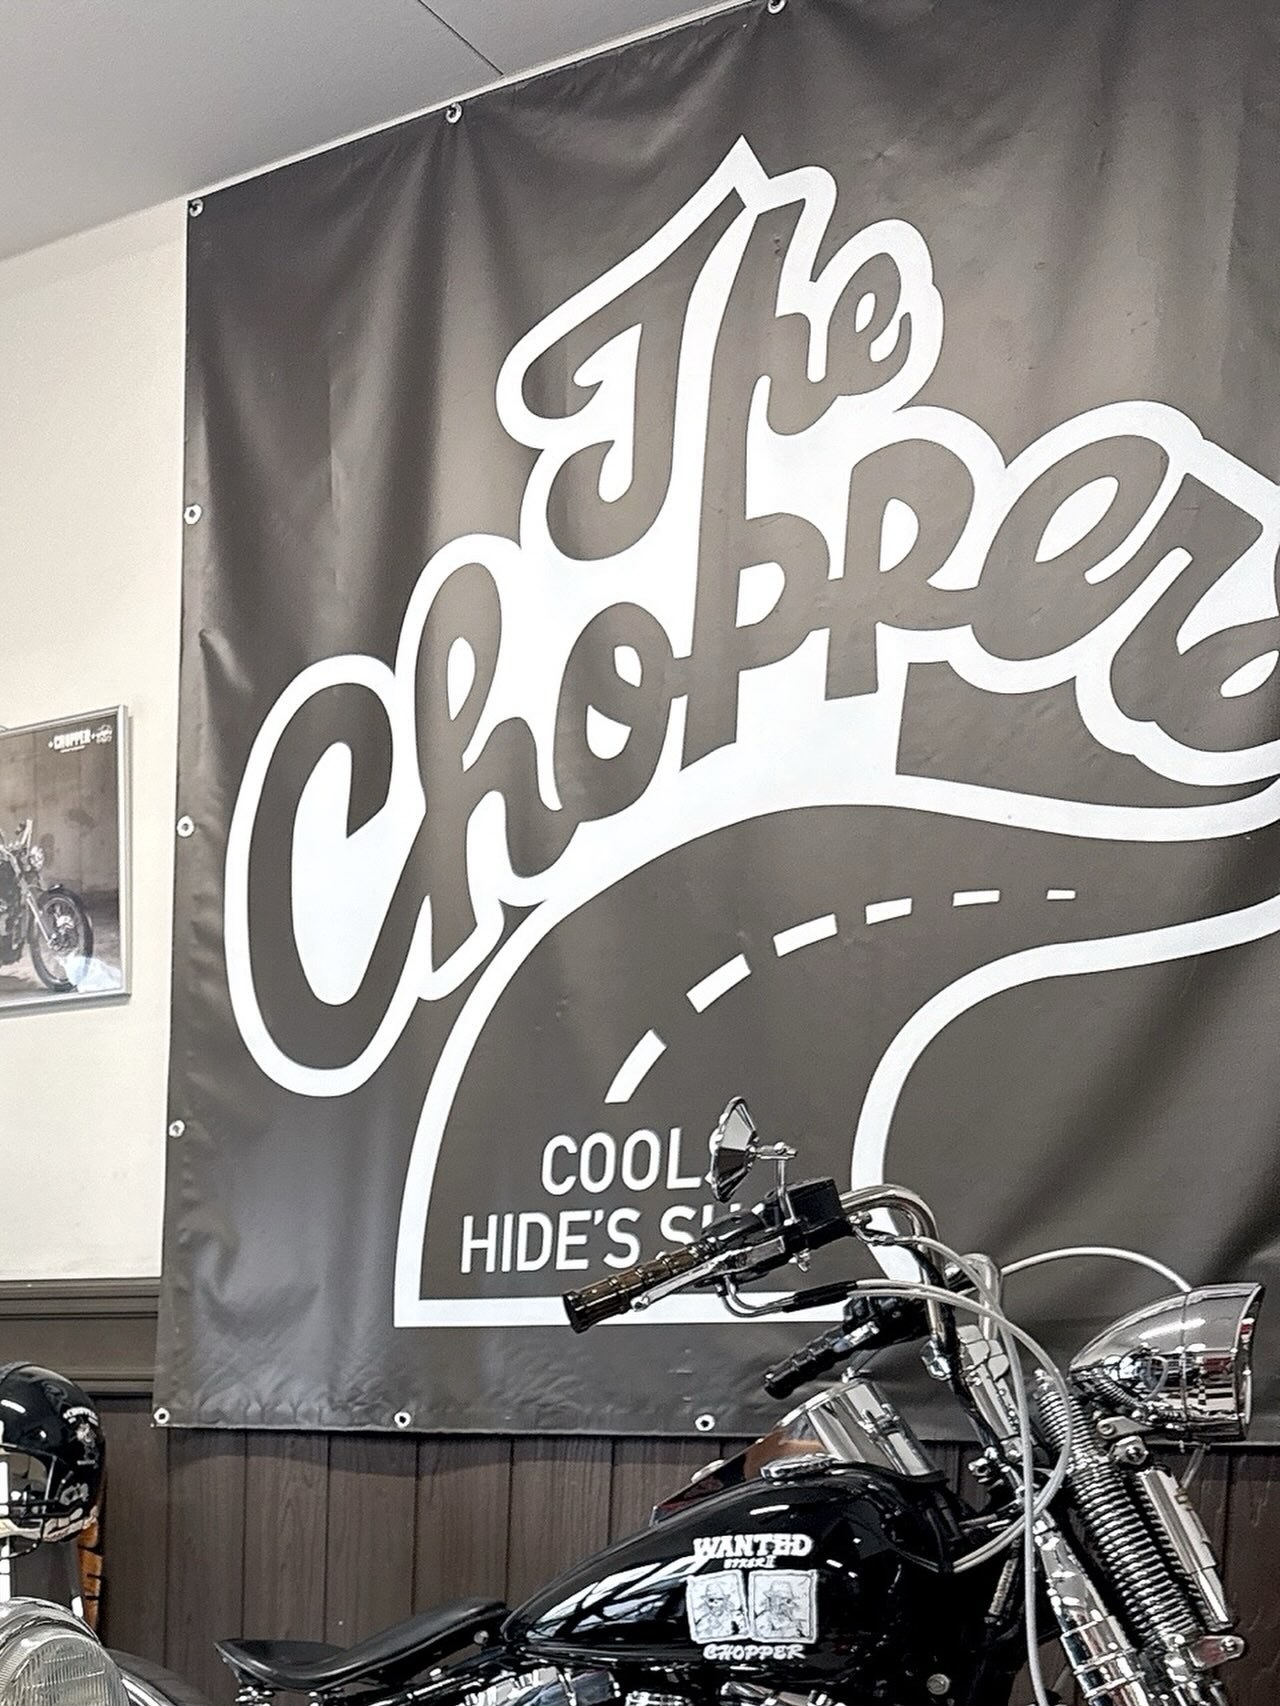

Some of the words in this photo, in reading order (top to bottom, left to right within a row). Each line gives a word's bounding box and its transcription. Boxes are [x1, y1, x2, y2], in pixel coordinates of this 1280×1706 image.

[520, 187, 915, 560] The
[460, 1208, 642, 1274] HIDE'S
[693, 1534, 813, 1559] WANTED
[702, 1644, 807, 1661] CHOPPER
